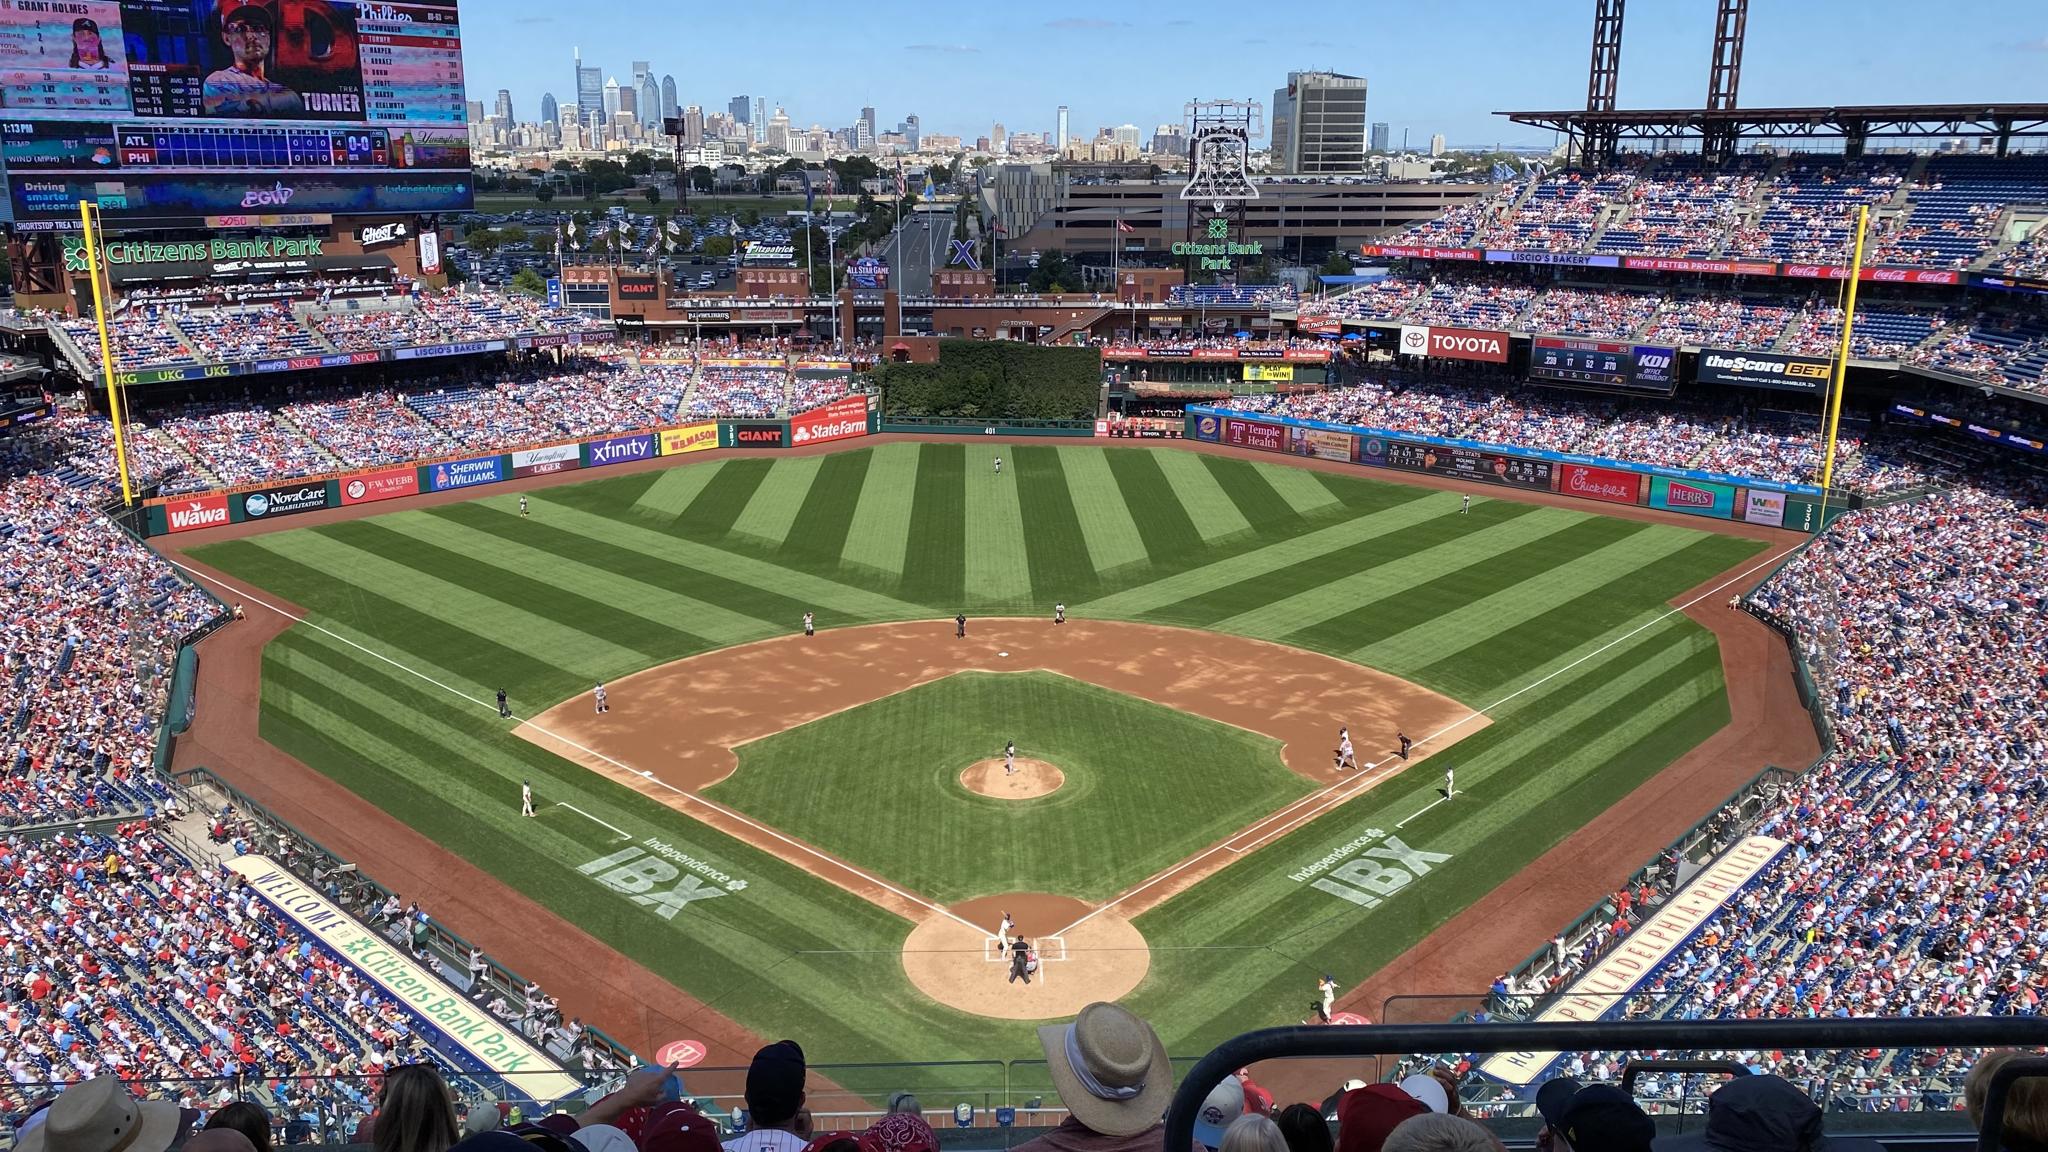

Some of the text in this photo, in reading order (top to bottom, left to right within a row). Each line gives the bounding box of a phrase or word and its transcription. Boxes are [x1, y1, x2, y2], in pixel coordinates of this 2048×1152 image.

[18, 0, 88, 14] GRANT HOLMES
[356, 2, 412, 22] Phillies
[302, 92, 361, 112] TURNER
[3, 124, 33, 133] 1:13 PM
[125, 136, 149, 146] ATL
[128, 153, 150, 163] PHI
[25, 182, 66, 192] Driving
[27, 193, 69, 201] smarter
[243, 190, 290, 206] PGW
[17, 221, 72, 231] SHORTSTOP TREA
[362, 223, 397, 245] GHOST
[106, 234, 323, 264] Citizens Bank Park
[746, 241, 795, 254] Fitzpatrick
[1172, 241, 1262, 255] Citizens Bank
[1382, 248, 1405, 256] Phillies
[1201, 256, 1231, 270] Park
[1512, 252, 1591, 264] LISCIO'S BAKERY
[858, 266, 873, 274] STAR
[873, 266, 890, 274] GAME
[1629, 259, 1654, 267] WHEY
[1657, 260, 1689, 270] BETTER
[1691, 262, 1730, 272] PROTEIN
[1789, 265, 1819, 277] Coca-Cola
[1874, 269, 1907, 281] Coca-Cola
[1917, 271, 1951, 283] Coca-Cola
[621, 284, 655, 293] GIANT
[1310, 321, 1324, 329] THIS
[534, 336, 566, 345] TOYOTA
[583, 332, 615, 342] TOYOTA
[415, 342, 487, 357] LISCIO'S BAKERY
[1433, 334, 1501, 354] TOYOTA
[291, 359, 320, 368] NECA
[352, 353, 379, 362] NECA
[1567, 358, 1594, 369] 17 52
[1638, 355, 1671, 368] KDI
[204, 366, 230, 377] UKG
[1706, 355, 1828, 376] theScore BET
[158, 370, 185, 381] UKG
[1636, 373, 1669, 382] TECHNOLOGY
[738, 431, 781, 441] GIANT
[811, 420, 866, 439] State Farm
[1248, 425, 1280, 438] Temple
[594, 439, 648, 461] xfinity
[1248, 438, 1278, 449] Health
[525, 450, 567, 464] Yuengling
[1465, 450, 1481, 458] STATS
[368, 463, 405, 473] ASPLUNDH
[413, 457, 449, 467] ASPLUNDH
[450, 460, 494, 475] SHERWIN
[533, 462, 562, 473] LAGER
[272, 475, 313, 488] ASPLUNDH
[319, 469, 361, 481] ASPLUNDH
[450, 471, 497, 486] WILLIAMS.
[220, 483, 263, 495] ASPLUNDH
[368, 475, 413, 490] F.W. WEBB
[1570, 473, 1627, 498] Chick-fil-A
[166, 491, 212, 503] ASPLUNDH
[270, 487, 326, 506] NovaCare
[1752, 497, 1780, 509] WM
[271, 500, 325, 513] REHABILITATION
[170, 507, 228, 529] Wawa
[1804, 504, 1812, 531] 330
[643, 837, 730, 883] Independence
[1288, 835, 1372, 882] Independence
[1310, 835, 1454, 909] IBX
[1692, 841, 1774, 902] PHILLIES
[576, 846, 729, 920] IBX
[254, 870, 347, 933] WELCOME
[1558, 904, 1706, 1021] PHILADELPHIA
[360, 949, 533, 1074] Citizens Bank Park
